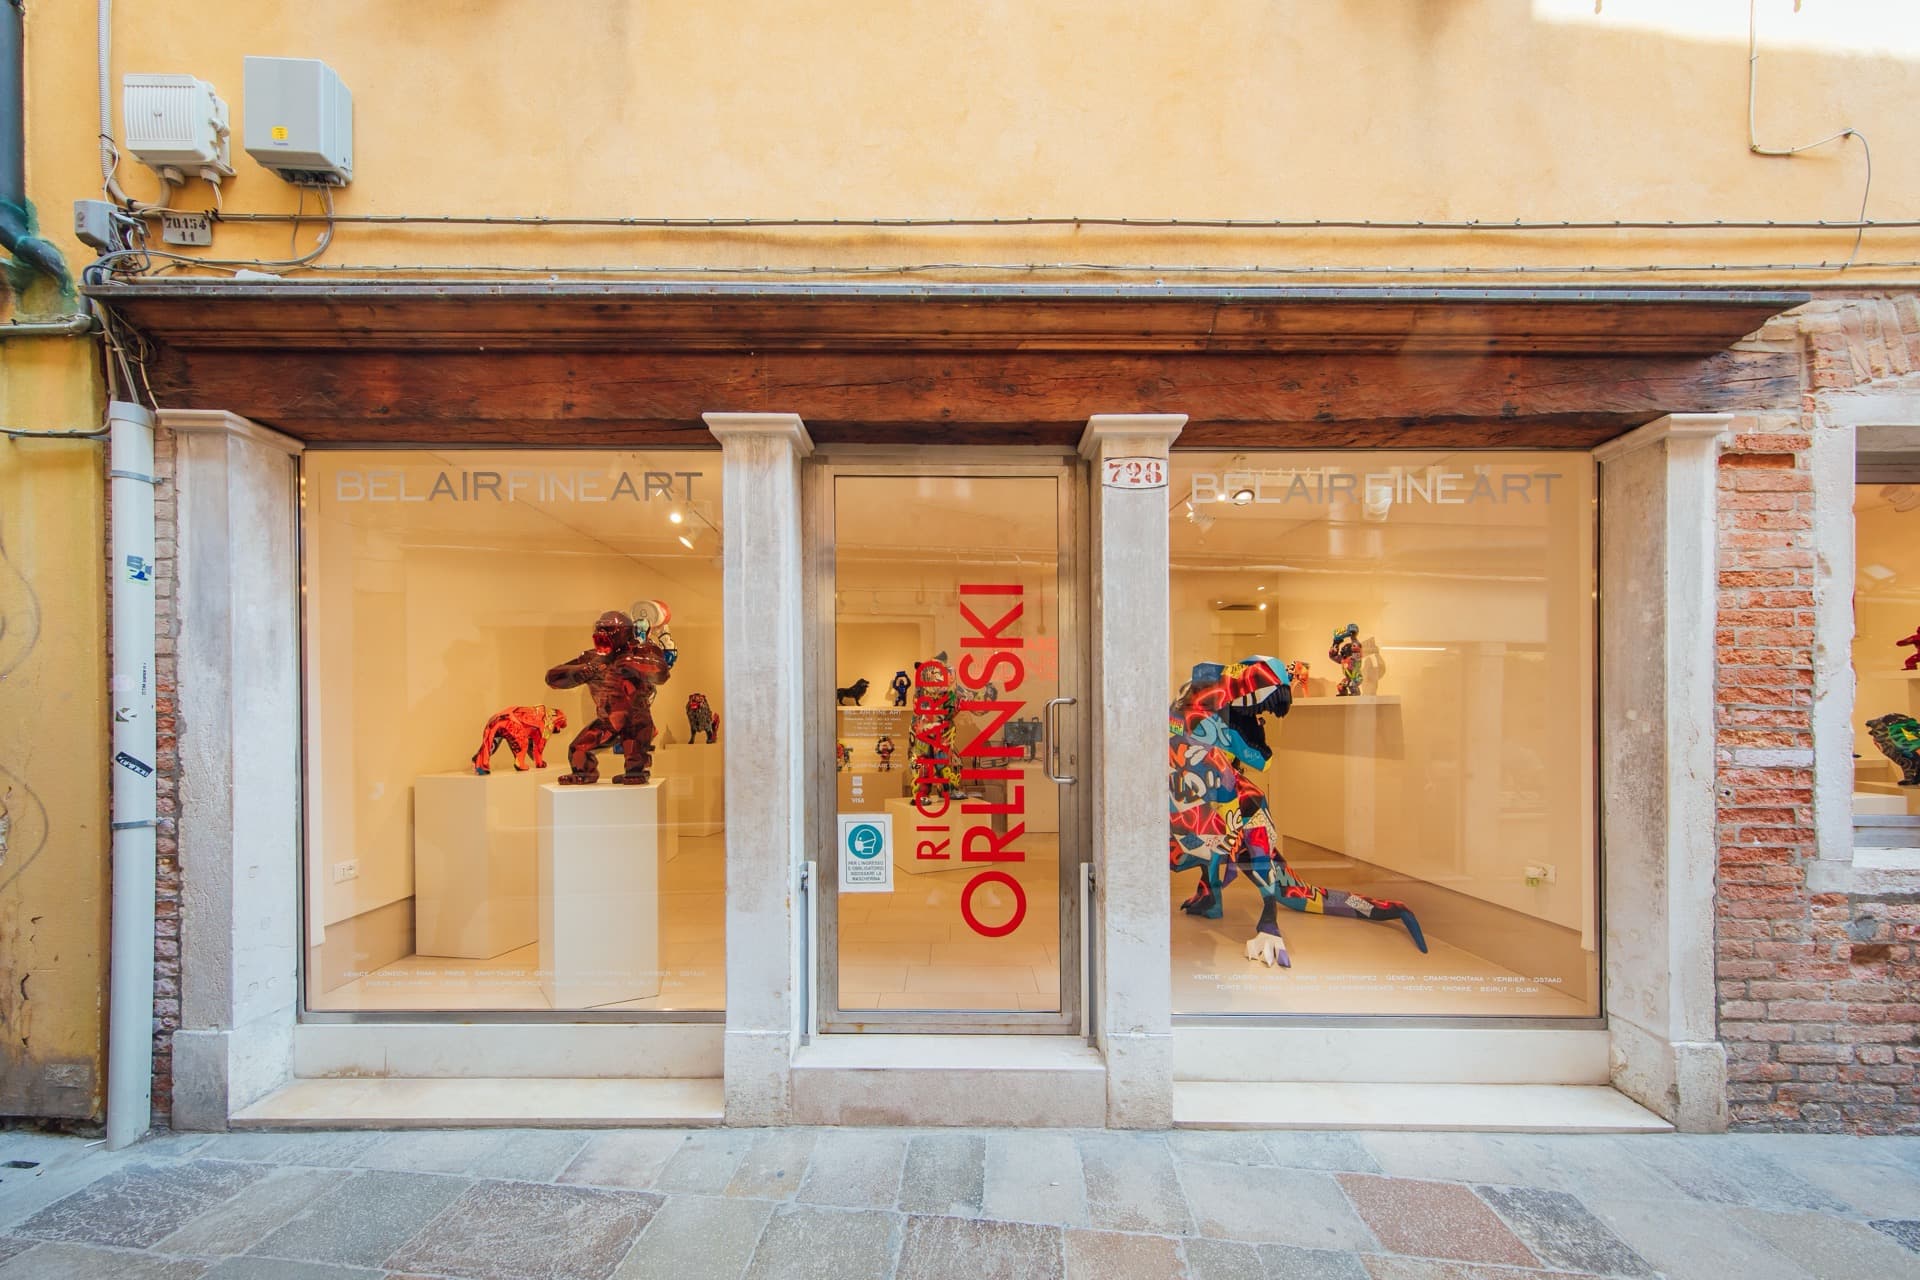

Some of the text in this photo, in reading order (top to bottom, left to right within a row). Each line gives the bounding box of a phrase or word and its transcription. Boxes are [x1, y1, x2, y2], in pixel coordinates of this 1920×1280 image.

[1109, 462, 1162, 484] 728
[914, 660, 950, 860] RICHARD
[960, 584, 1027, 938] ORLINSKI
